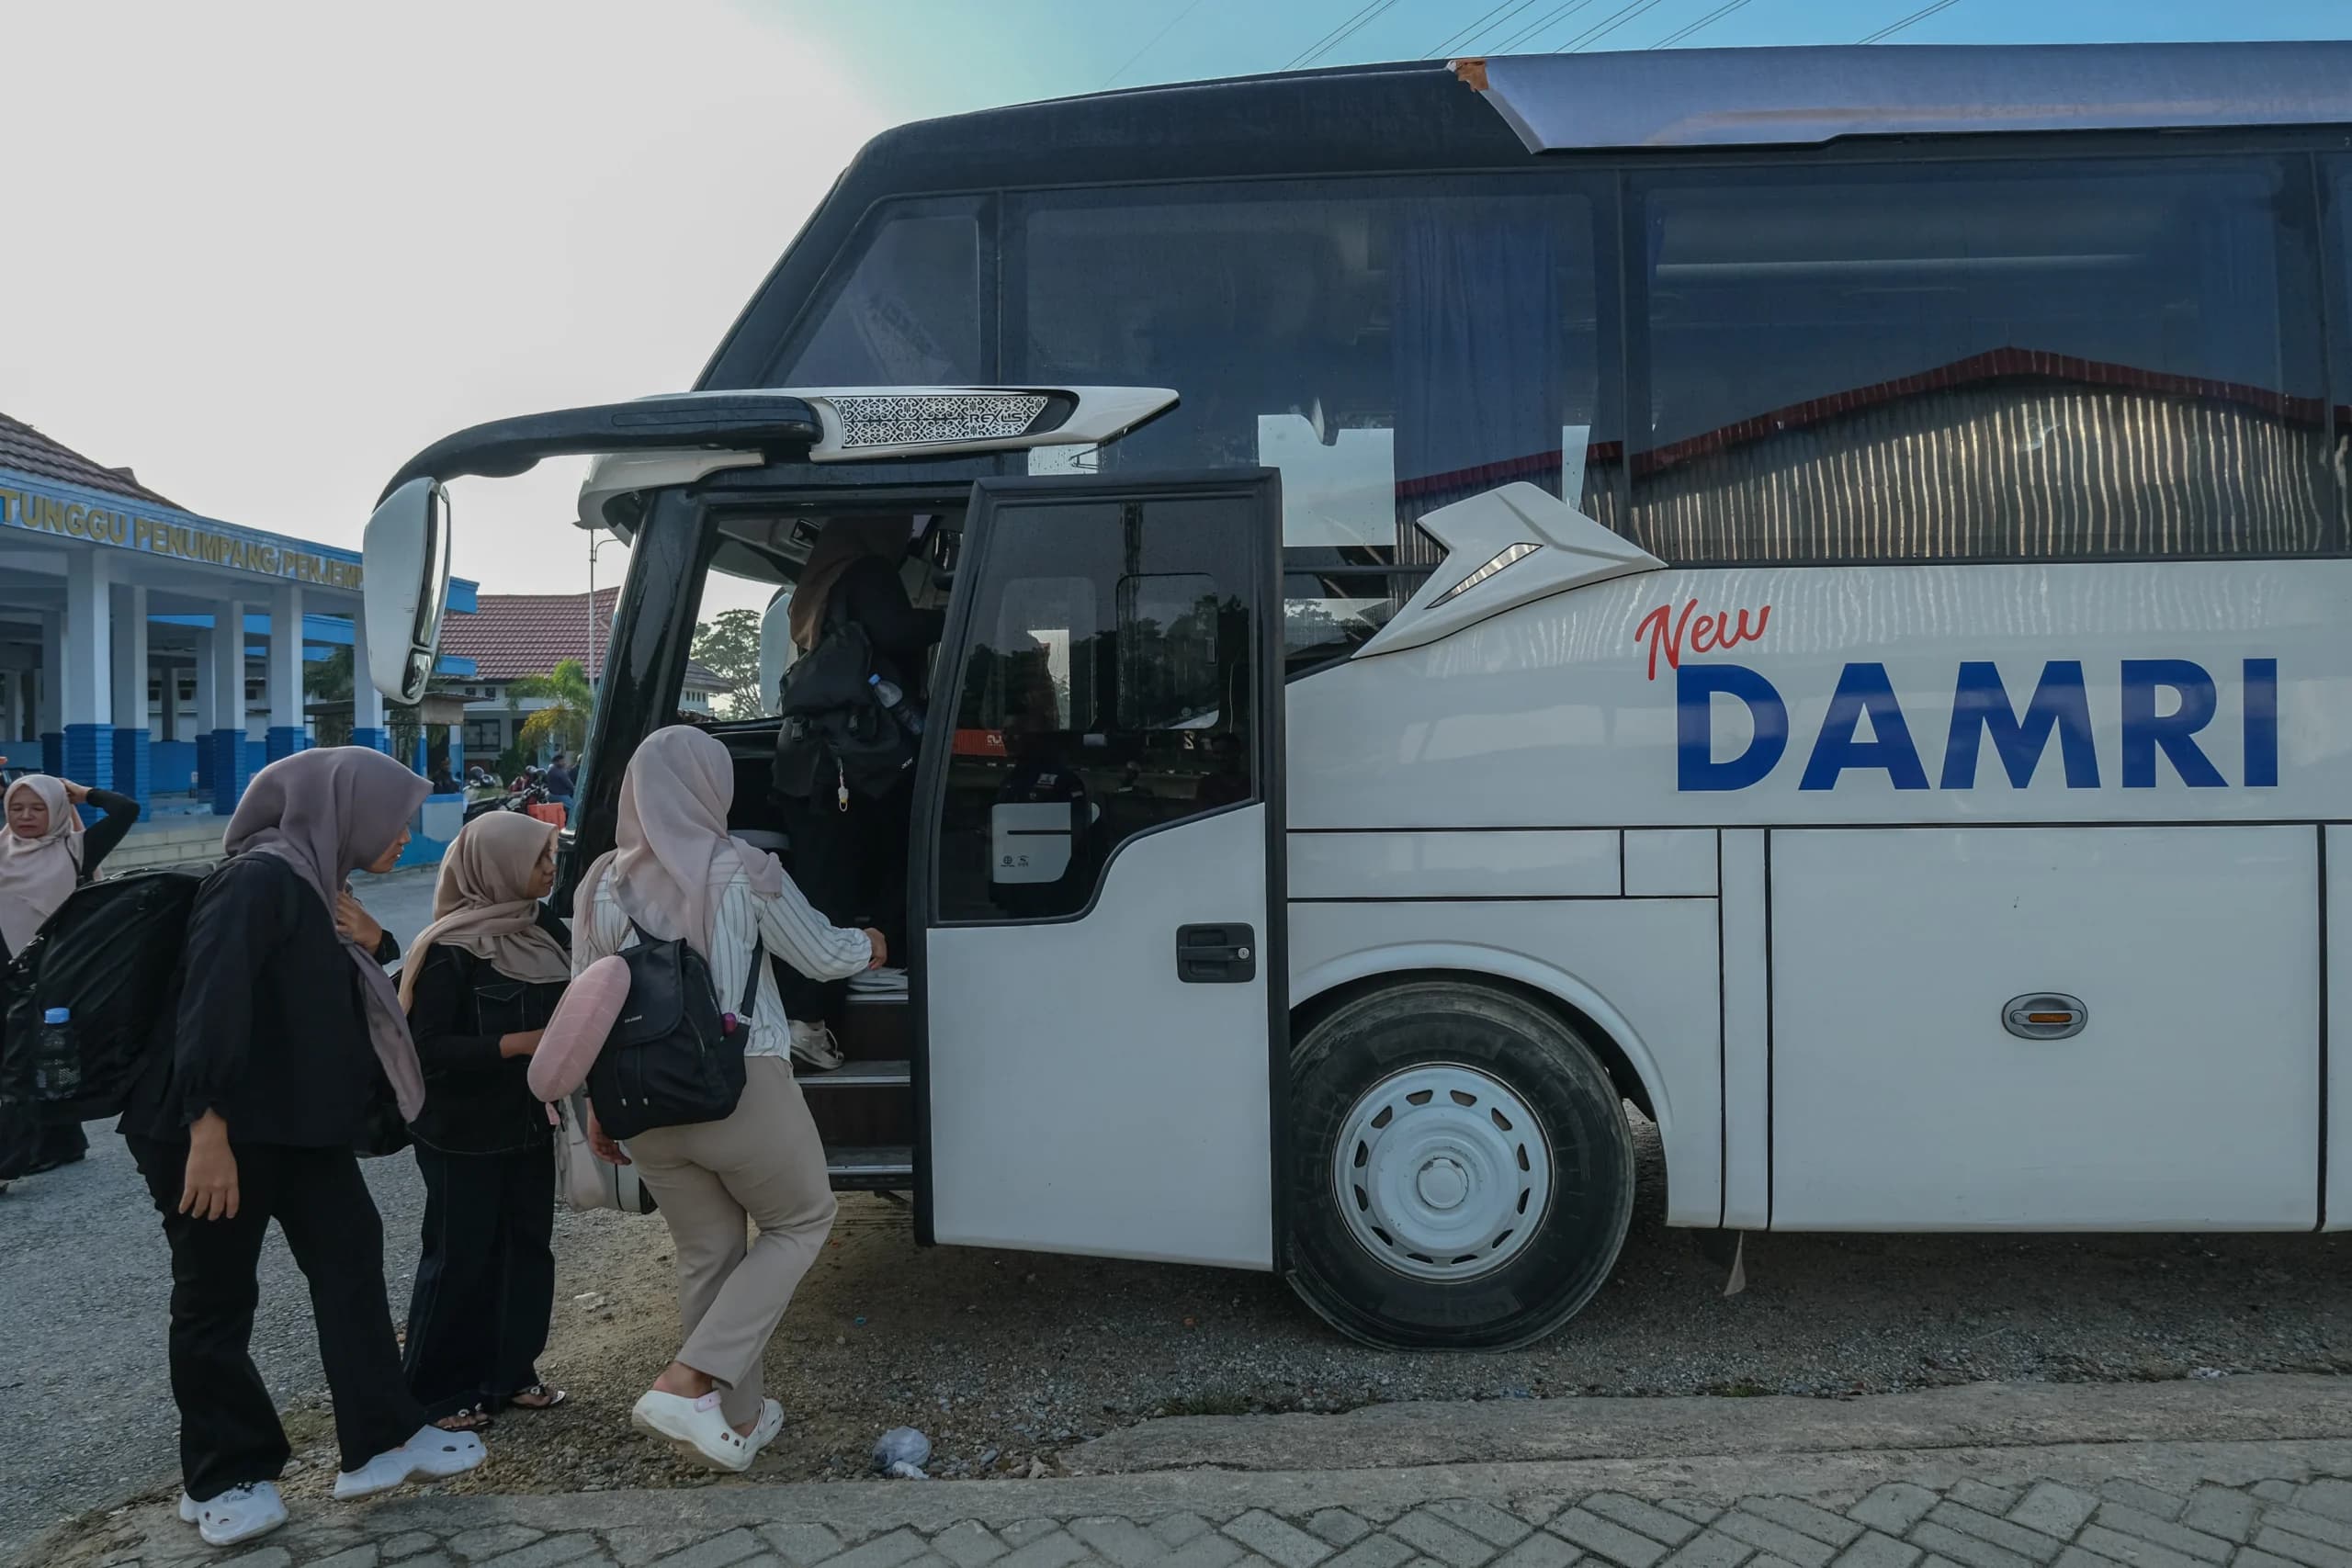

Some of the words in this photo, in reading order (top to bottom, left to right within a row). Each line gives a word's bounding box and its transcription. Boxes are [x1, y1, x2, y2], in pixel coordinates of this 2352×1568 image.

[969, 409, 1023, 426] REXUS
[0, 489, 127, 544] TUNGGU
[1634, 598, 1771, 681] New
[1676, 658, 2278, 792] DAMRI
